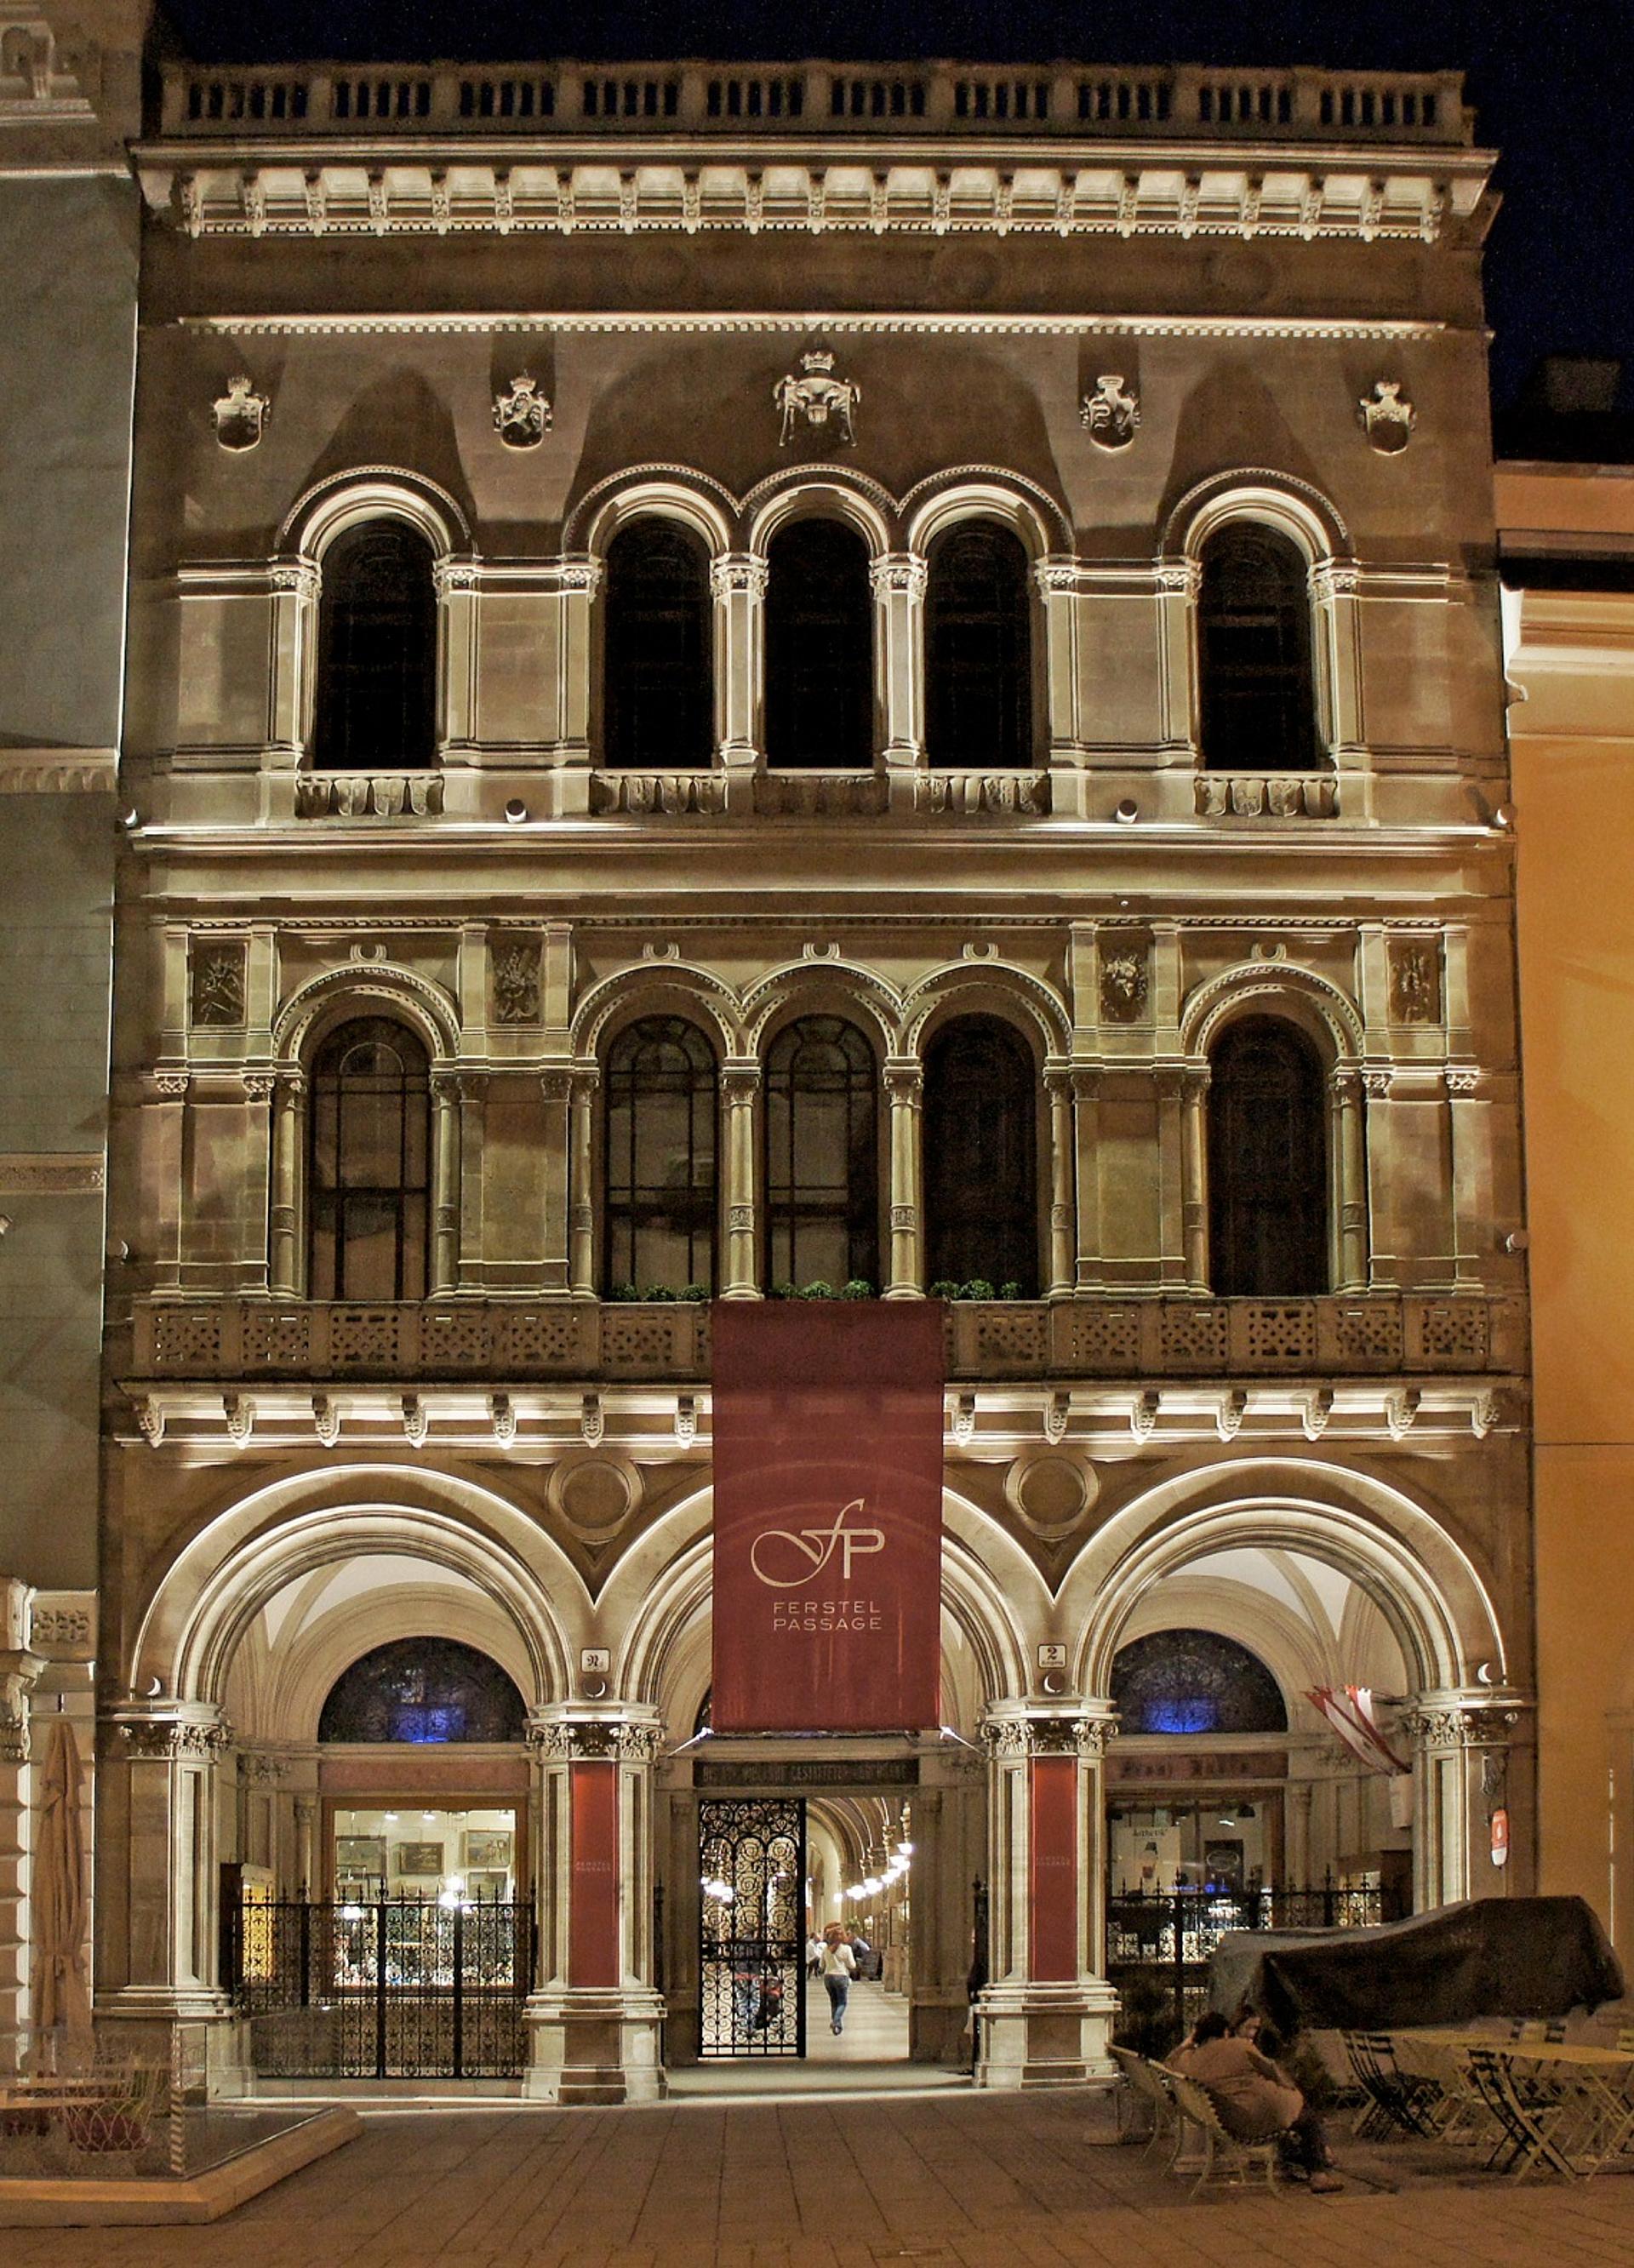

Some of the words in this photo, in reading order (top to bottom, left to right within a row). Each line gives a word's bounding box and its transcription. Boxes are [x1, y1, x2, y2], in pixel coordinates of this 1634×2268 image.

[773, 1601, 881, 1614] FERSTEL
[773, 1616, 883, 1631] PASSAGE
[1047, 1646, 1058, 1660] 2
